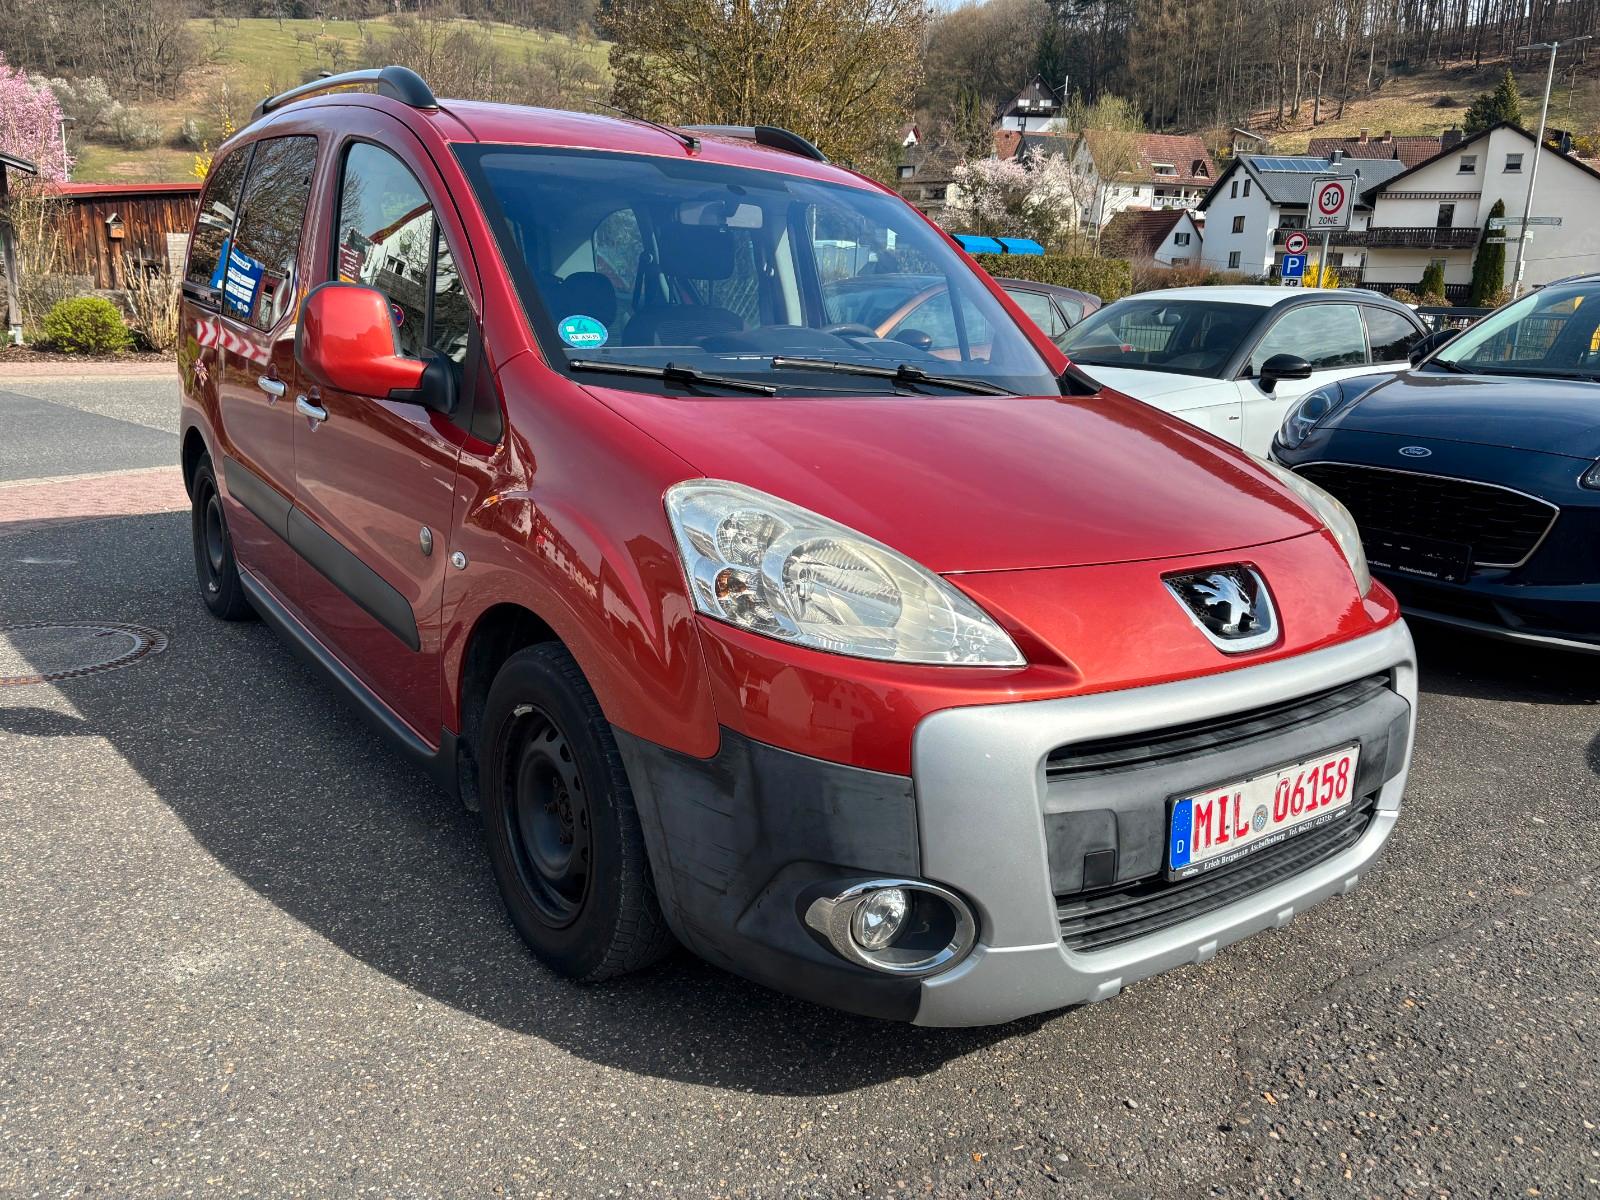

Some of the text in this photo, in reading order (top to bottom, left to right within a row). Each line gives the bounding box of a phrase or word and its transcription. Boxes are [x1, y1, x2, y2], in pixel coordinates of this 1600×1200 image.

[1323, 191, 1339, 206] 30
[1318, 216, 1338, 225] ZONE
[1286, 257, 1300, 274] P
[1176, 756, 1350, 854] D MIL 06158
[1203, 858, 1220, 870] Erich
